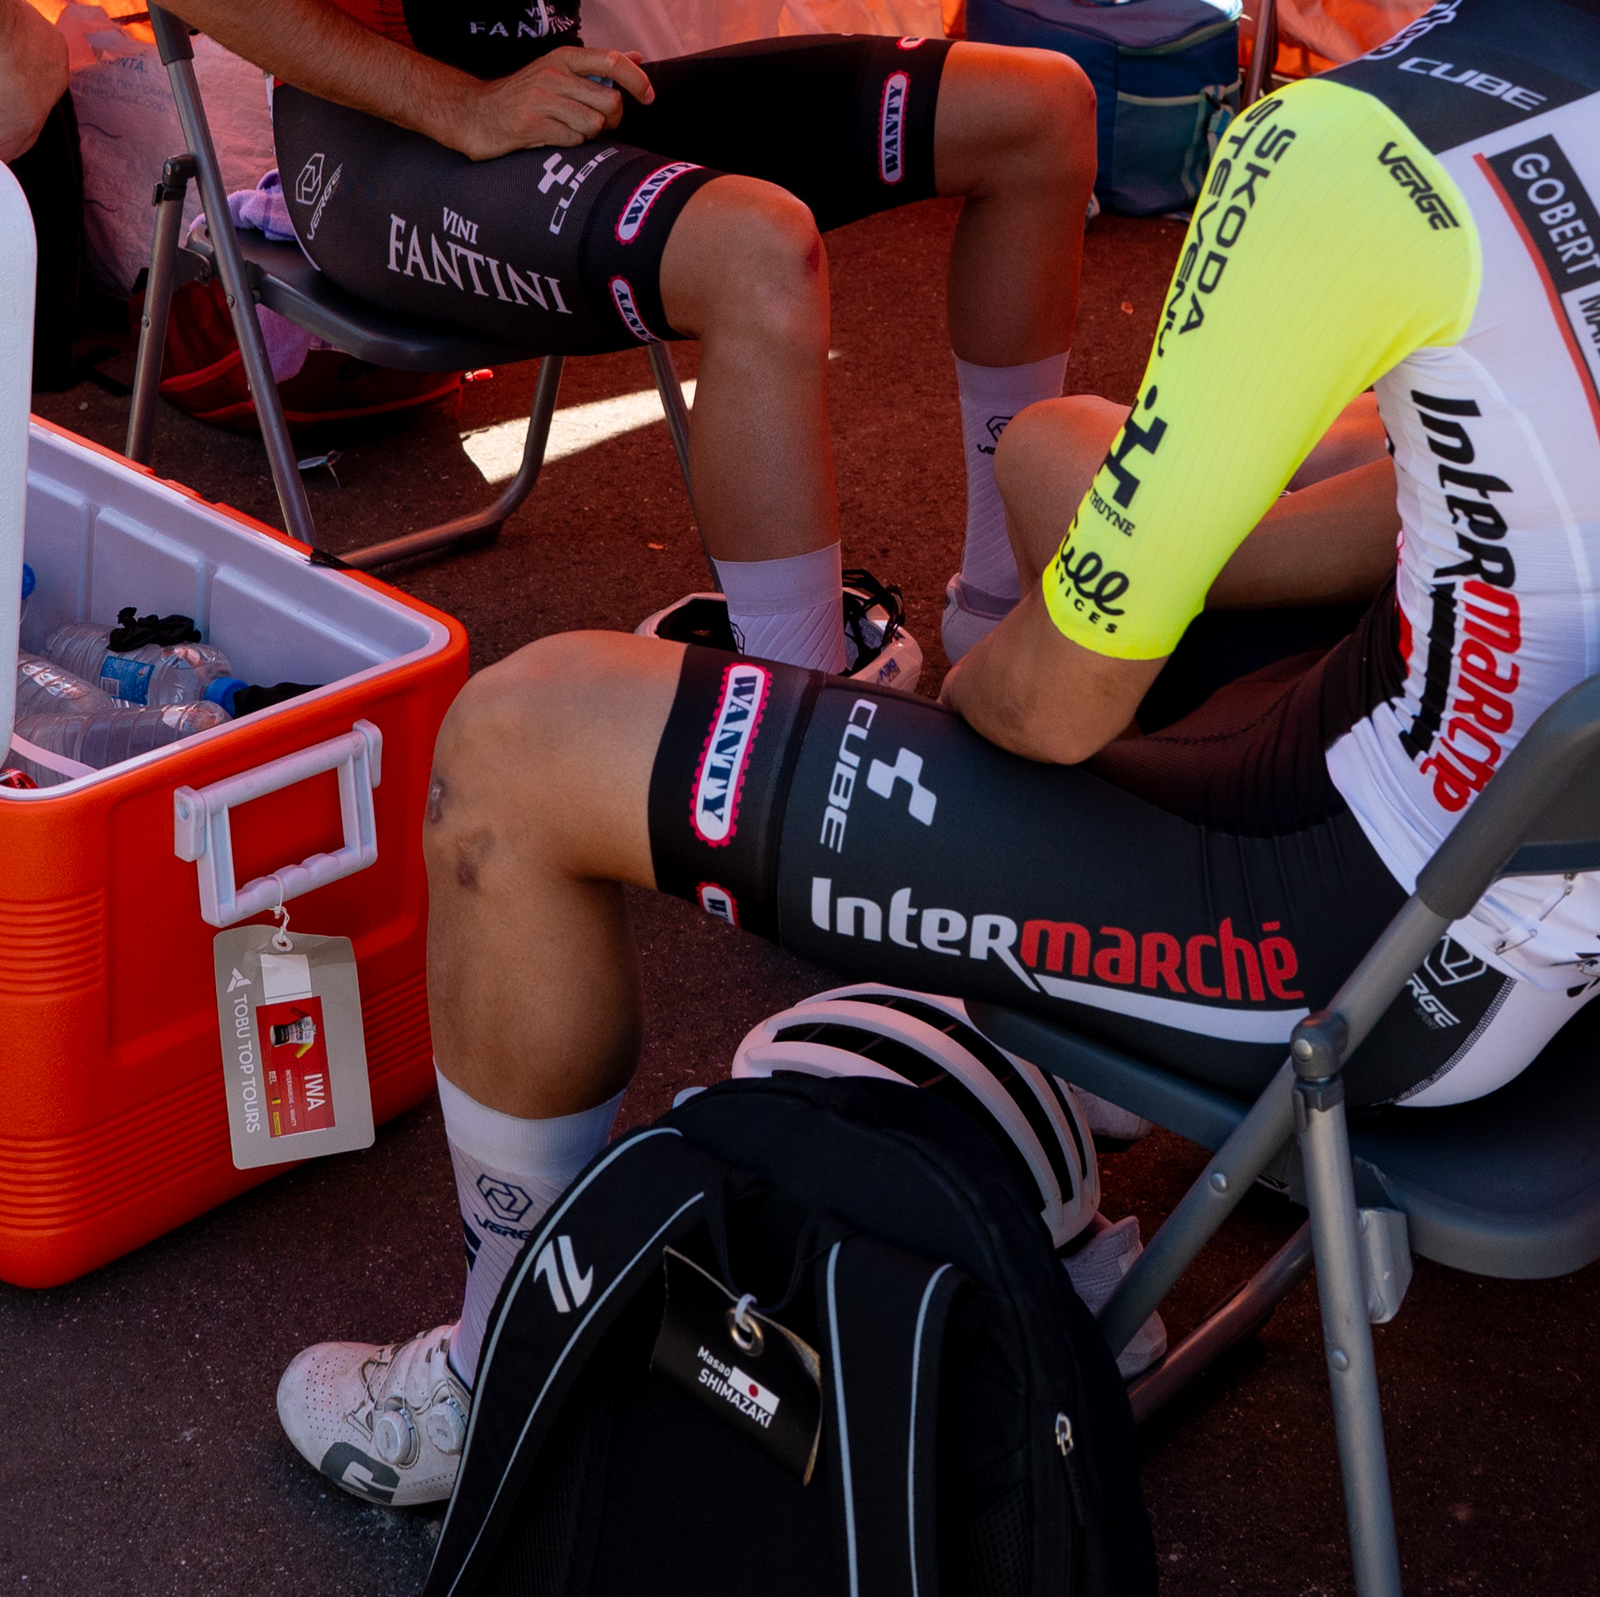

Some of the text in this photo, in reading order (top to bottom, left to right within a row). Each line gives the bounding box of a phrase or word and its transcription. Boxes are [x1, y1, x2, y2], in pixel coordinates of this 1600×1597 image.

[1397, 56, 1548, 111] CUBE
[884, 85, 903, 174] WANTY
[442, 206, 479, 245] VINI
[550, 146, 619, 235] CUBE
[623, 162, 692, 227] WANTY
[1178, 123, 1296, 335] SKODA
[1377, 141, 1460, 230] VERGE
[386, 212, 573, 315] FANTINI
[702, 675, 758, 823] WANTY
[819, 698, 879, 854] CUBE
[233, 993, 261, 1134] TOBU TOP TOURS
[268, 1070, 277, 1085] BEL
[303, 1072, 326, 1112] IWA
[697, 1345, 732, 1377] Masao
[698, 1368, 773, 1429] SHIMAZAKI
